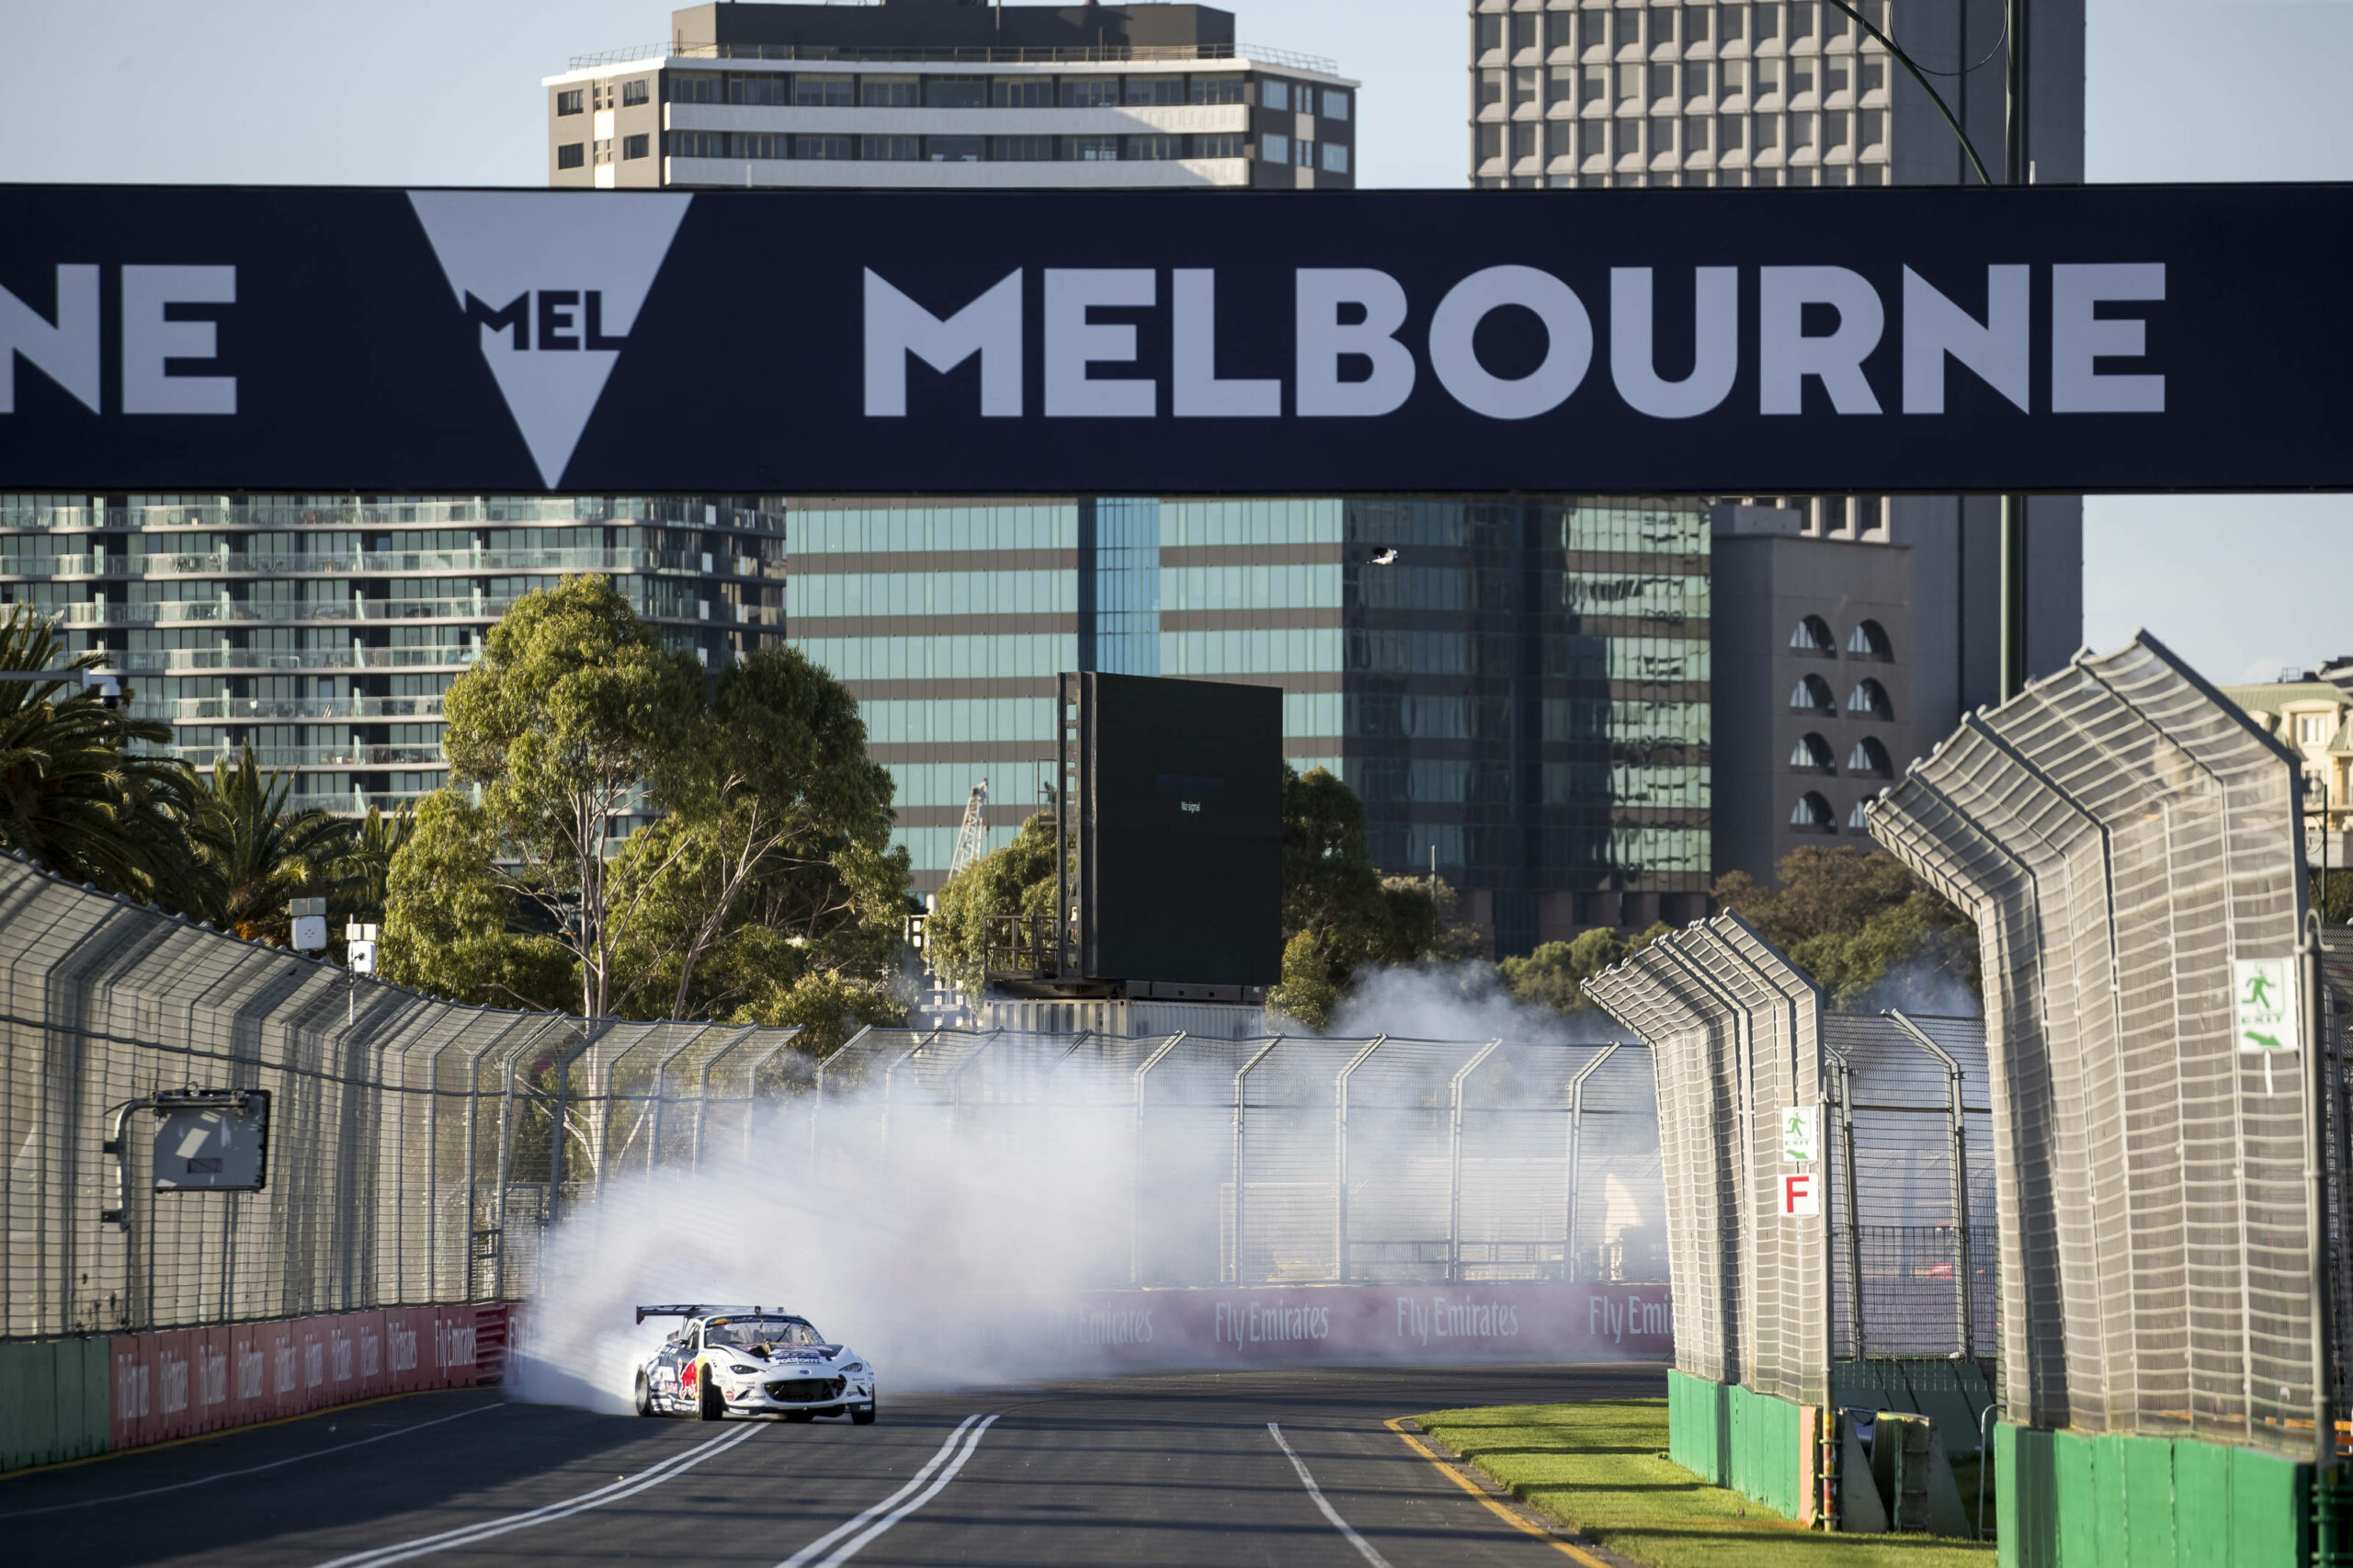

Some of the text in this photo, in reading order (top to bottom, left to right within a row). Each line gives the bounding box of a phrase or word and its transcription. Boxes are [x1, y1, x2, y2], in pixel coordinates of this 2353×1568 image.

[0, 263, 236, 415] NE
[464, 290, 629, 351] MEL
[862, 263, 2166, 419] MELBOURNE
[2242, 1014, 2282, 1023] EXIT
[1786, 1176, 1810, 1213] F
[1079, 1301, 1153, 1345] Emirates
[1215, 1297, 1330, 1351] Fly Emirates
[1396, 1295, 1518, 1346] Fly Emirates
[1589, 1295, 1623, 1344] Fly
[435, 1319, 447, 1379] Fly
[448, 1316, 476, 1368] Emirates
